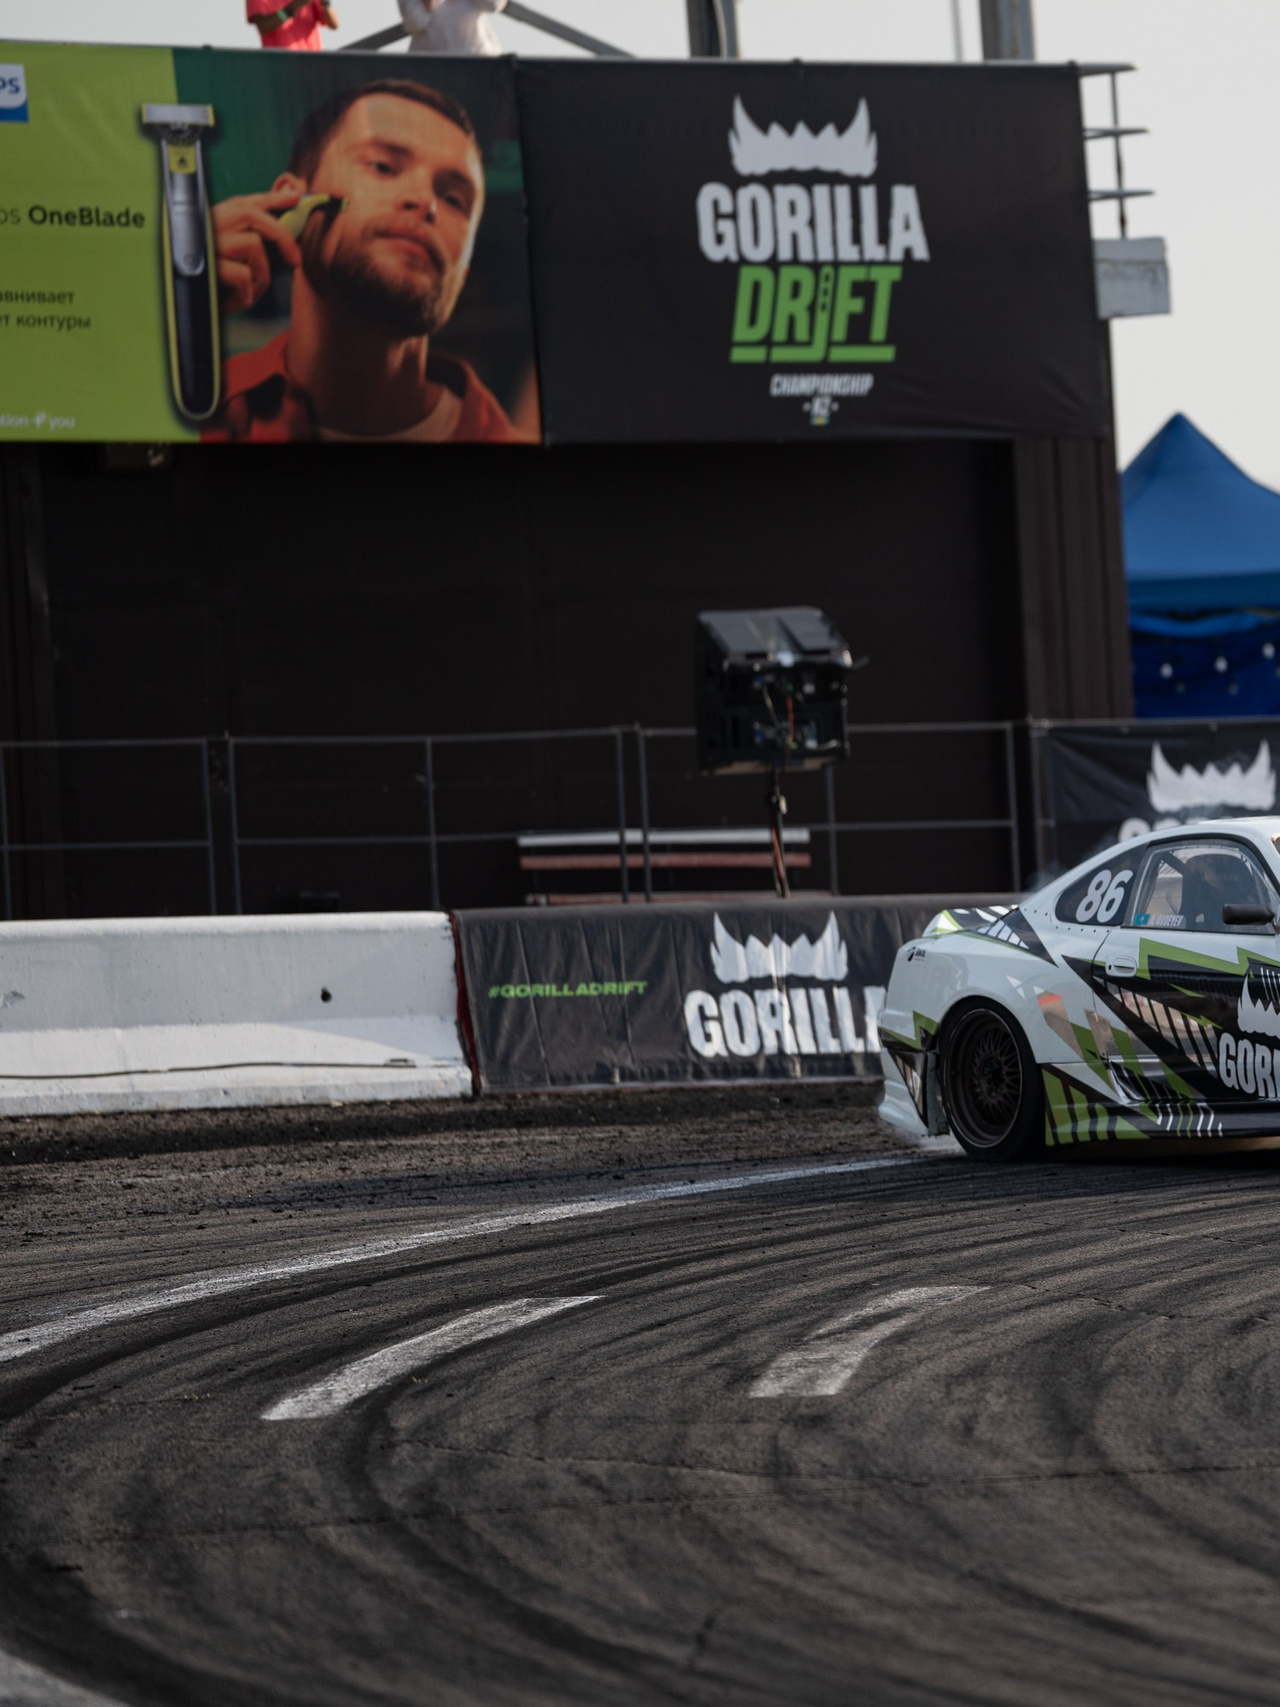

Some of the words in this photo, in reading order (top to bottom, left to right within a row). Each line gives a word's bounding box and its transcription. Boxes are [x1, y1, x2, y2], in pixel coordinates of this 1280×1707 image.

[28, 204, 146, 229] OneBlade
[697, 182, 930, 262] GORILLA
[16, 315, 92, 332] контуры
[729, 265, 902, 363] DRIFT
[769, 373, 874, 397] CHAMPIONSHIP
[1075, 869, 1134, 924] 86
[488, 981, 648, 999] #GORILLADRIFT
